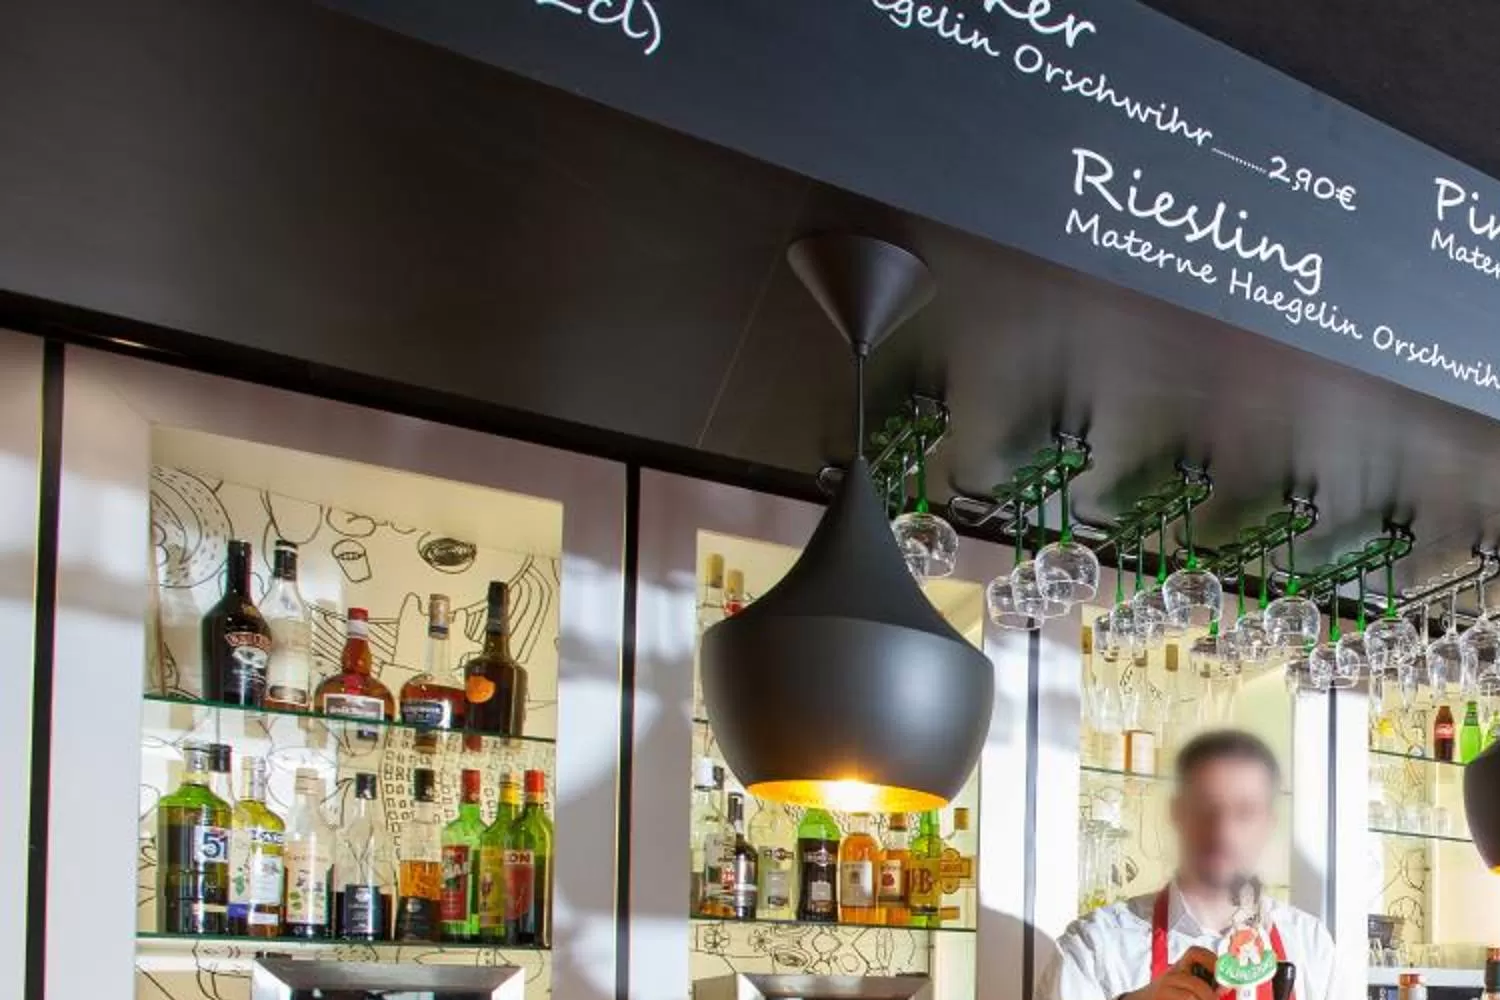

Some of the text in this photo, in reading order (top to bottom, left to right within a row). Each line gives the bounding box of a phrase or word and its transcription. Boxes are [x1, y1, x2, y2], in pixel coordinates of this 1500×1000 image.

[536, 0, 661, 55] cl)
[872, 0, 1357, 212] gelin Orschwihr 2,90€
[1064, 207, 1217, 284] Materne
[1229, 267, 1363, 339] Haegelin
[1071, 147, 1323, 297] Riesling
